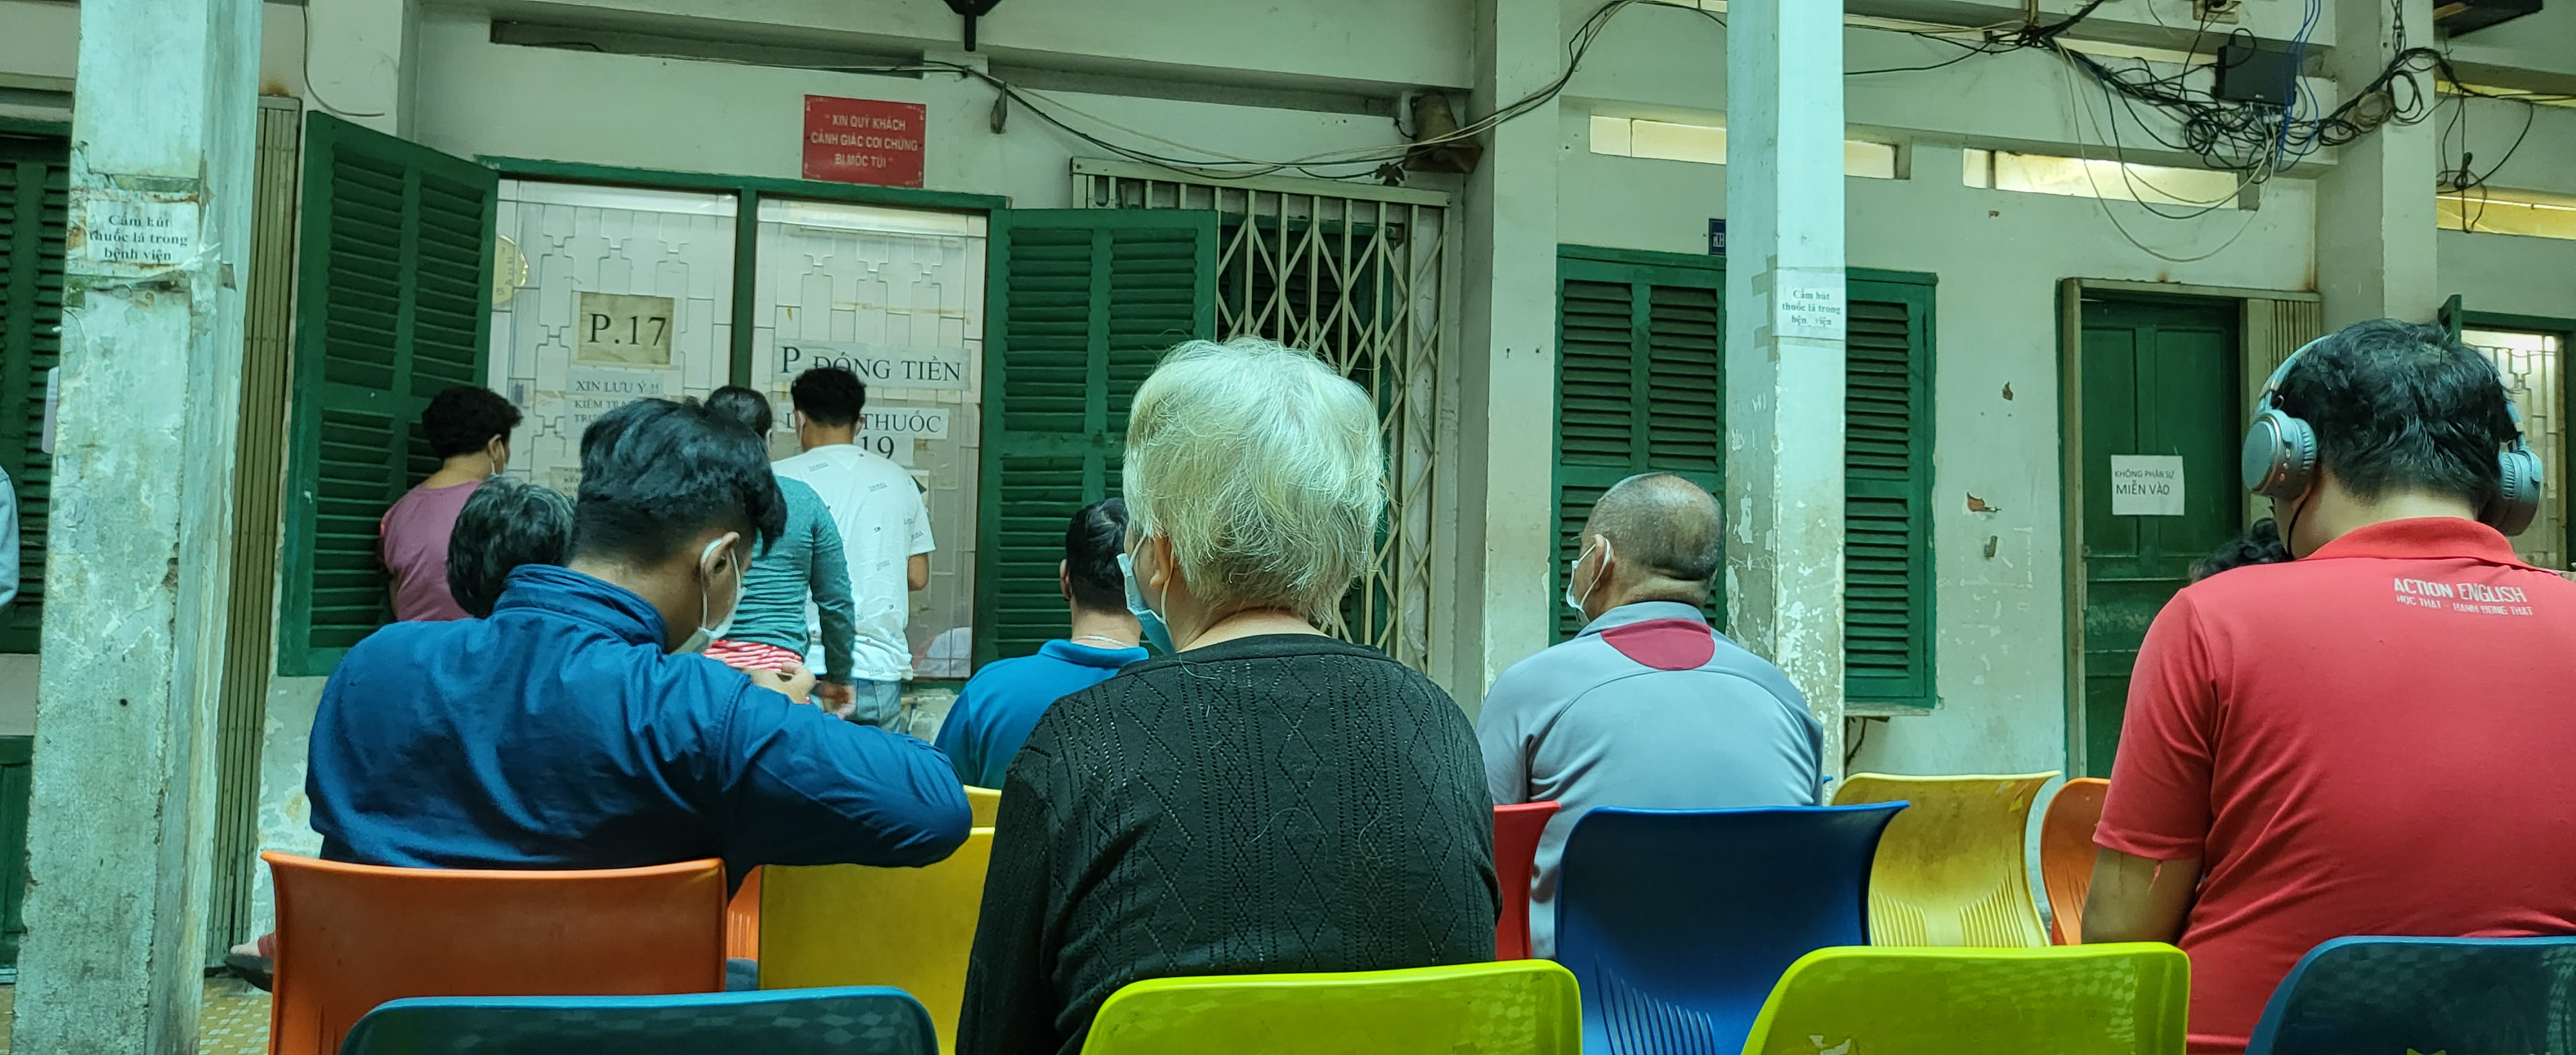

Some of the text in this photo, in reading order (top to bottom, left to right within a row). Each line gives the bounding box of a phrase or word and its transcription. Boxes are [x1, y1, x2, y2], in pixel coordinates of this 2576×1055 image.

[873, 116, 906, 131] KHÁCH
[840, 132, 864, 147] GIÁC
[866, 137, 883, 149] COI
[133, 232, 145, 243] lá
[150, 234, 188, 247] trong
[104, 247, 172, 263] bệnh viện
[1816, 292, 1830, 300] hút
[1782, 301, 1841, 315] thuốc lá trong
[781, 346, 801, 374] P
[901, 355, 963, 382] TIỀN
[575, 381, 601, 392] XIN
[605, 381, 634, 394] LƯU
[862, 410, 942, 433] THUỐC
[2115, 468, 2143, 478] KHÔNG
[2116, 480, 2170, 495] MIỄN VÀO
[2394, 578, 2528, 603] ACTION ENGLISH
